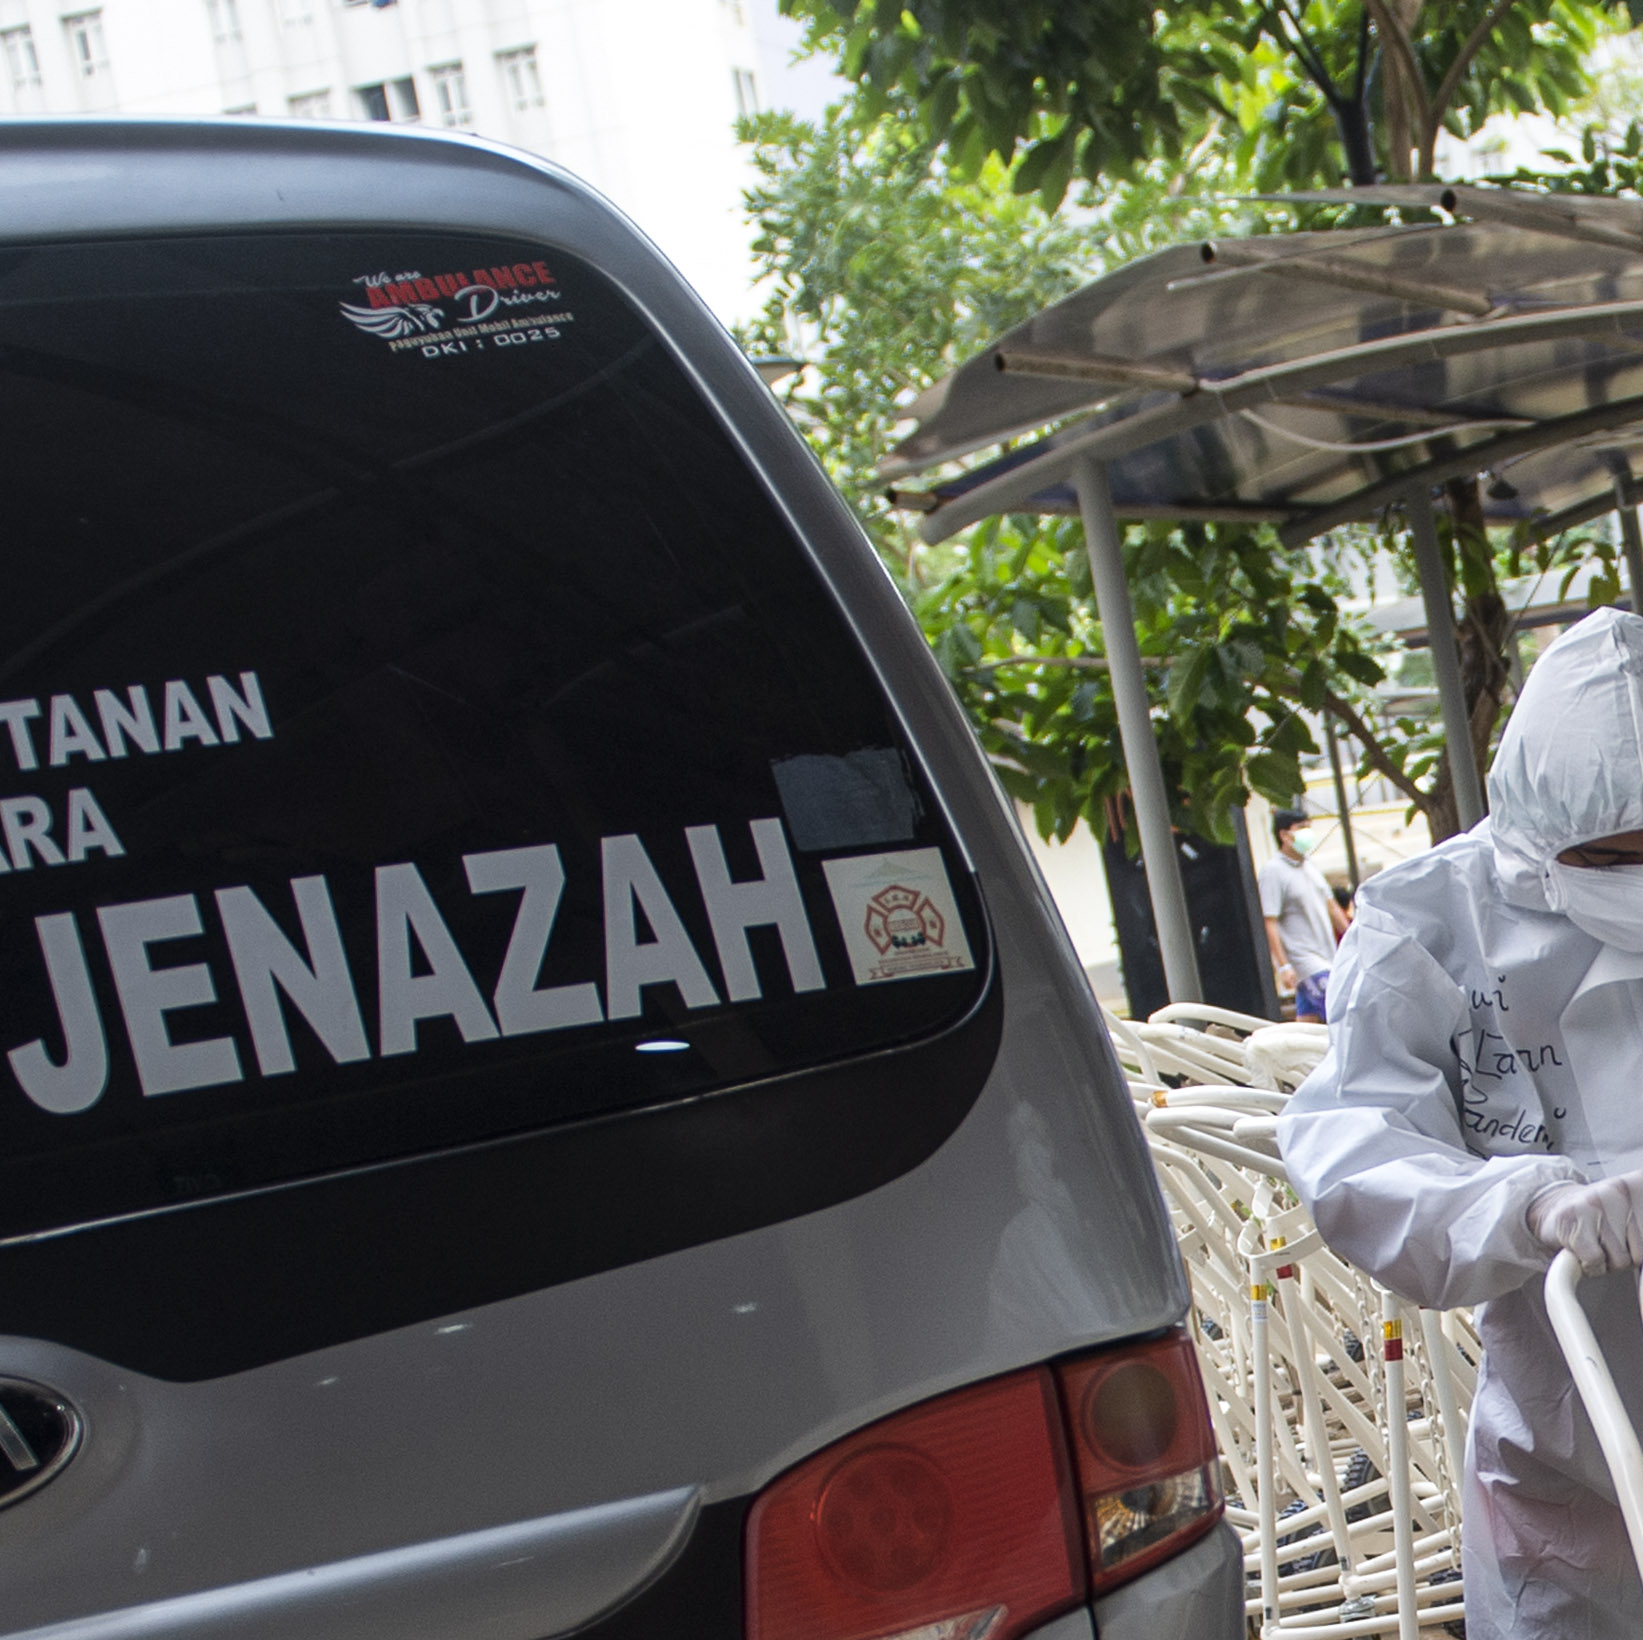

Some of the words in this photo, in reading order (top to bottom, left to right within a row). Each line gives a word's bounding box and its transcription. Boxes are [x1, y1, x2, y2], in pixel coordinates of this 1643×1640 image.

[366, 261, 556, 309] AMBULANCE
[454, 284, 561, 322] Driver
[421, 340, 468, 358] DKI
[493, 326, 561, 347] 0025
[0, 786, 127, 874] RA
[6, 816, 827, 1114] JENAZAH
